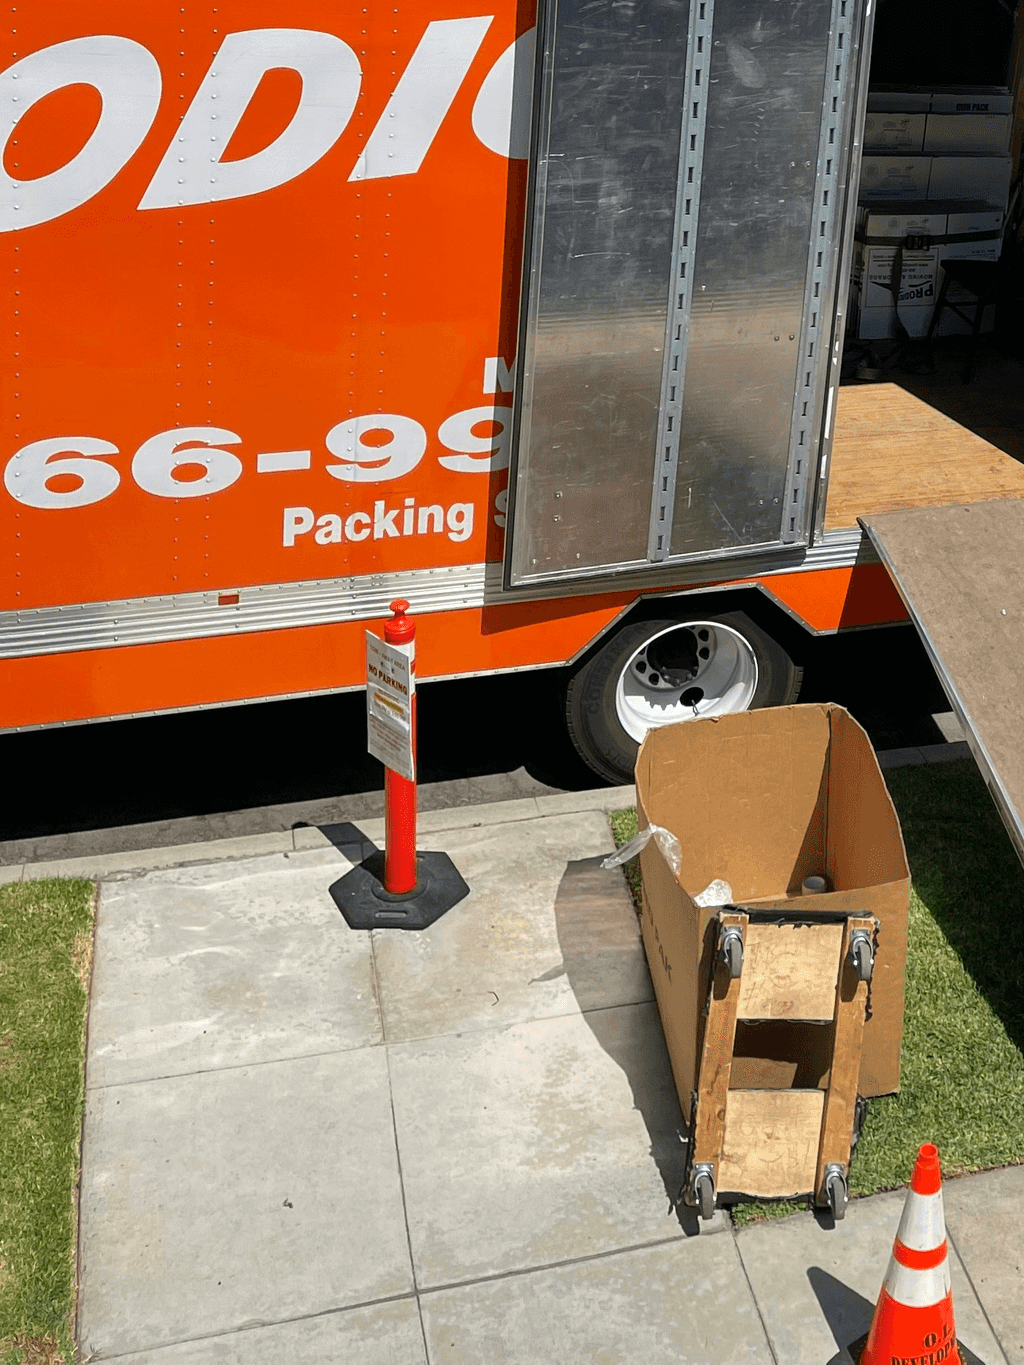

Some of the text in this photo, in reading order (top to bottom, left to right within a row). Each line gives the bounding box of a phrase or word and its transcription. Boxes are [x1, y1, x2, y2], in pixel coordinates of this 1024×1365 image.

[972, 103, 989, 112] PACK
[283, 498, 475, 549] Packing
[368, 663, 408, 695] NO PARKING
